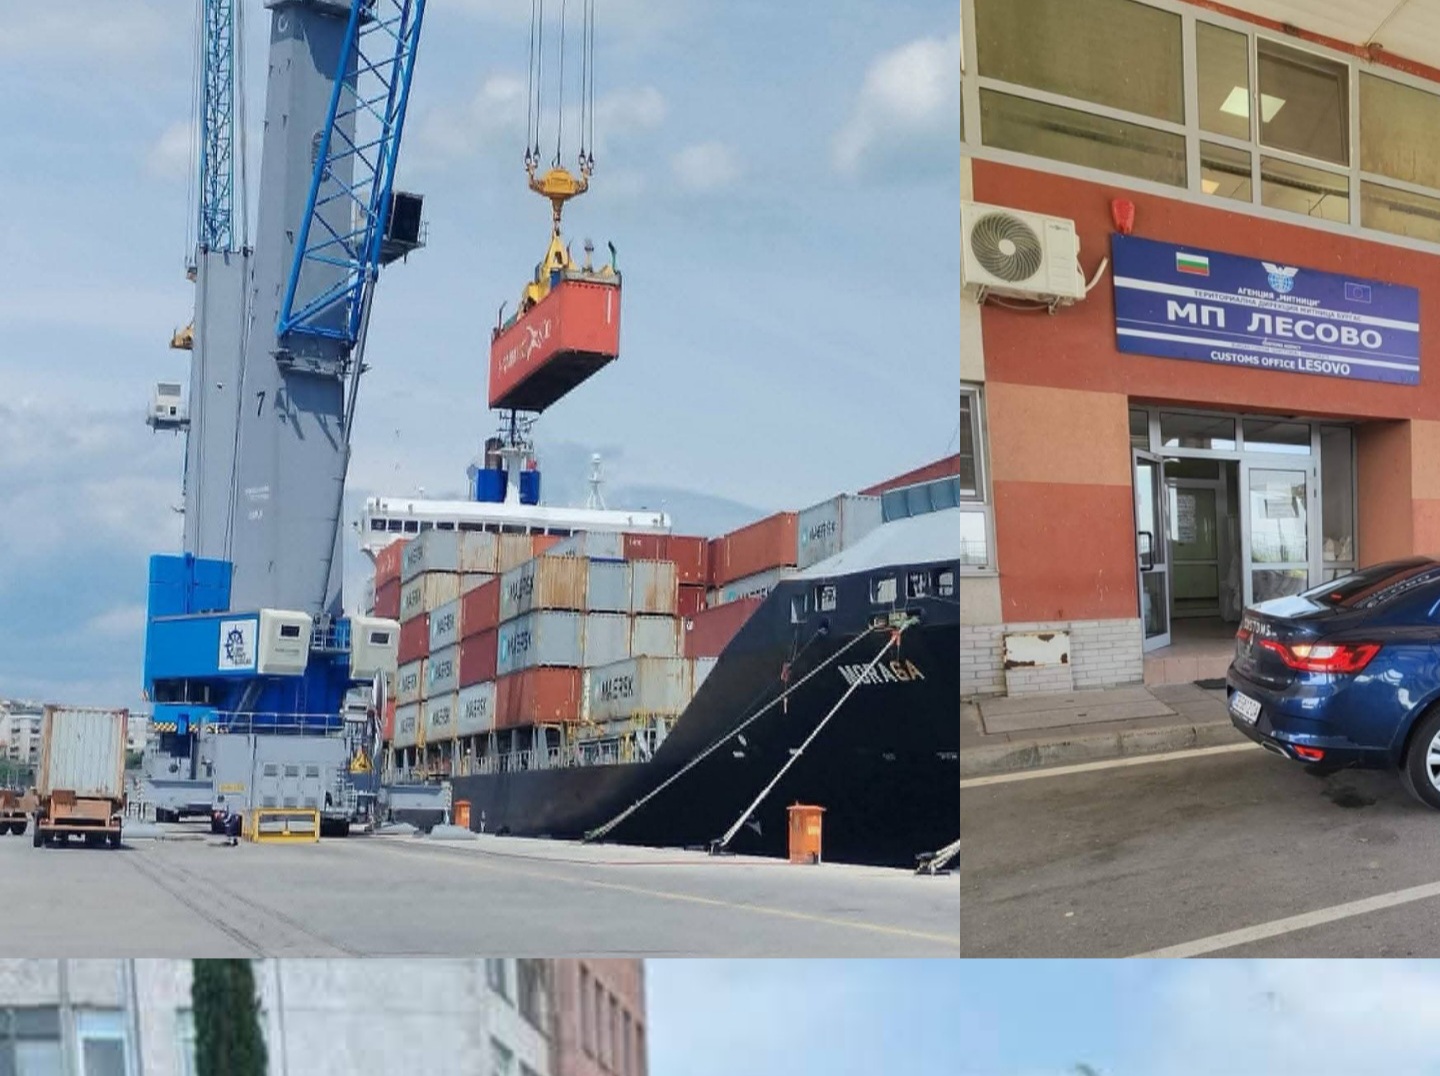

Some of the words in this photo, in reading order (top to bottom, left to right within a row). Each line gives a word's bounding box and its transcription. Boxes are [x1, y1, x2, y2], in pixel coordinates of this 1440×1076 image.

[1238, 287, 1275, 300] АГЕНЦИЯ
[1167, 300, 1226, 328] МП
[1247, 312, 1383, 349] ЛЕСОВО
[1210, 350, 1260, 365] CUSTOMS
[1261, 356, 1296, 370] OFFICE
[1298, 358, 1351, 375] LESOVO
